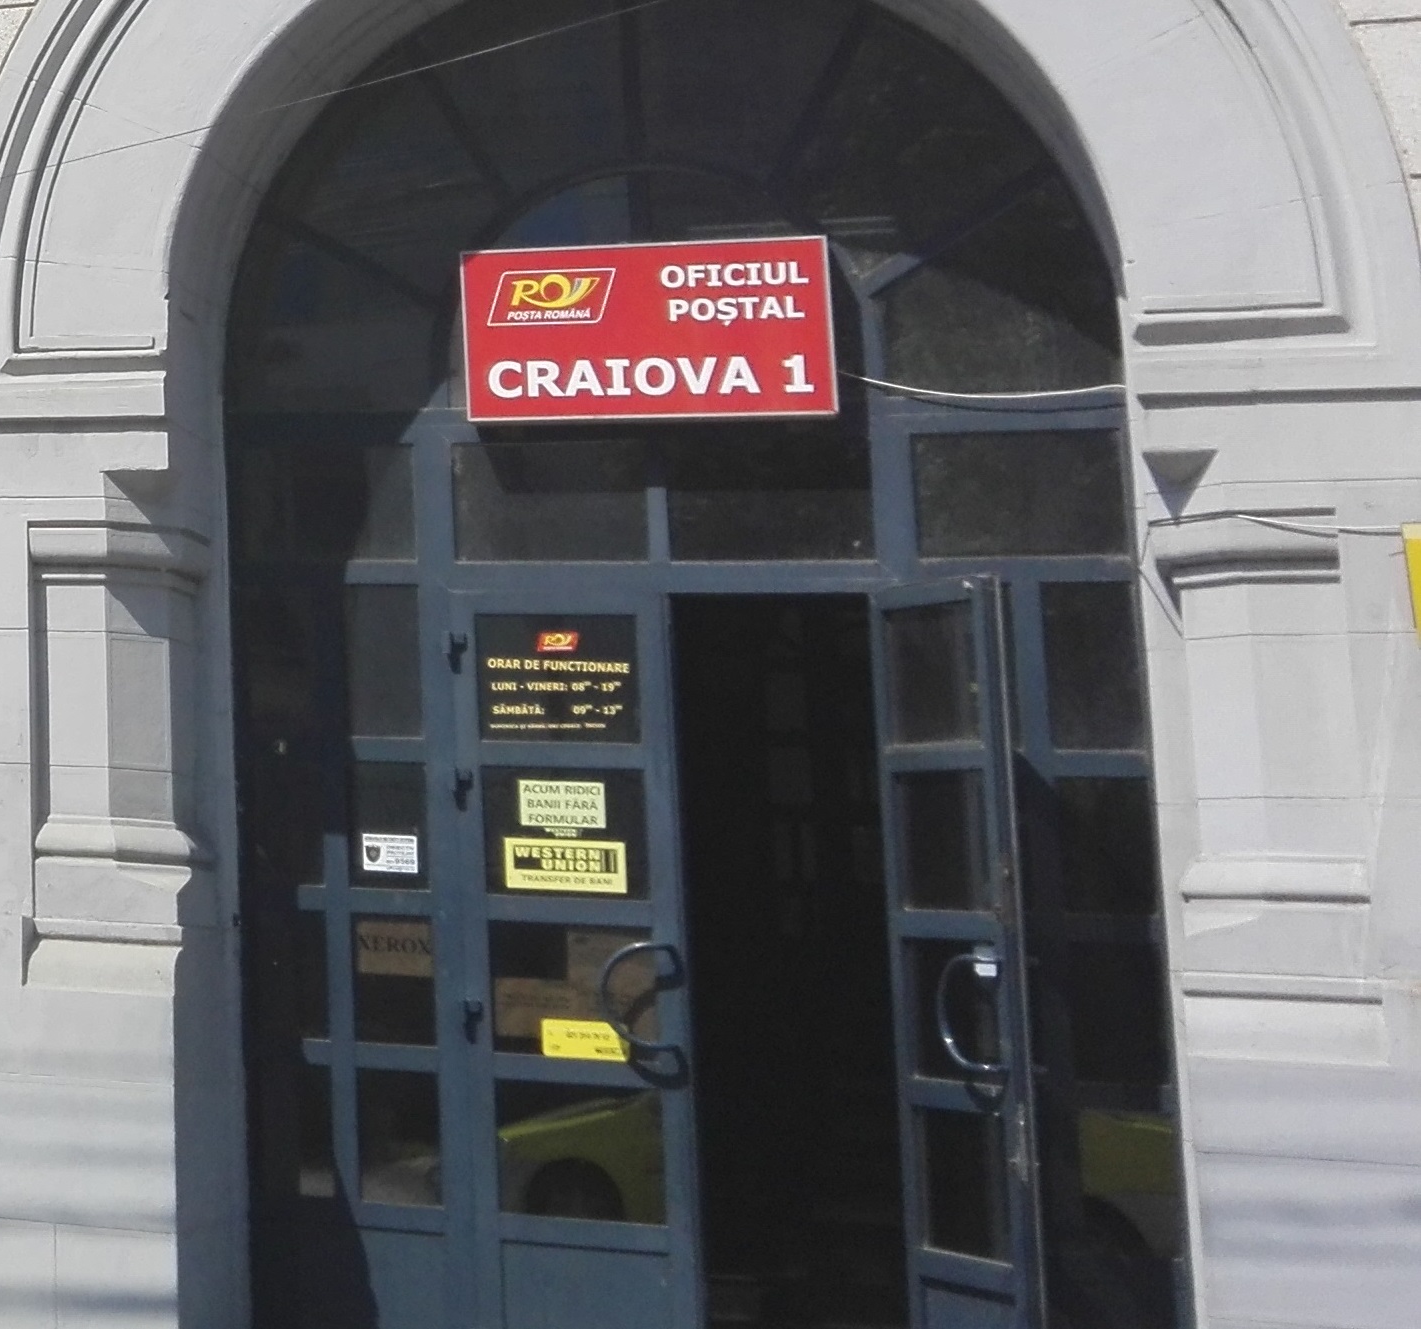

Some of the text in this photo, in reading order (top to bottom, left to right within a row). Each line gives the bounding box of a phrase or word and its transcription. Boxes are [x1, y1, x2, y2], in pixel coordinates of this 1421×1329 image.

[660, 261, 810, 289] OFICIUL
[487, 354, 815, 399] CRAIOVA 1
[487, 657, 521, 671] ORAR
[524, 658, 540, 671] DE
[491, 681, 517, 692] LUNI
[527, 681, 568, 692] VINERI:
[523, 784, 601, 796] ACUM RIDICI
[527, 799, 560, 810] BANII
[528, 813, 598, 826] FORMULAR
[514, 846, 601, 861] WESTERN
[540, 859, 601, 873] UNION
[521, 874, 571, 884] TRANSFER
[574, 875, 587, 885] DE
